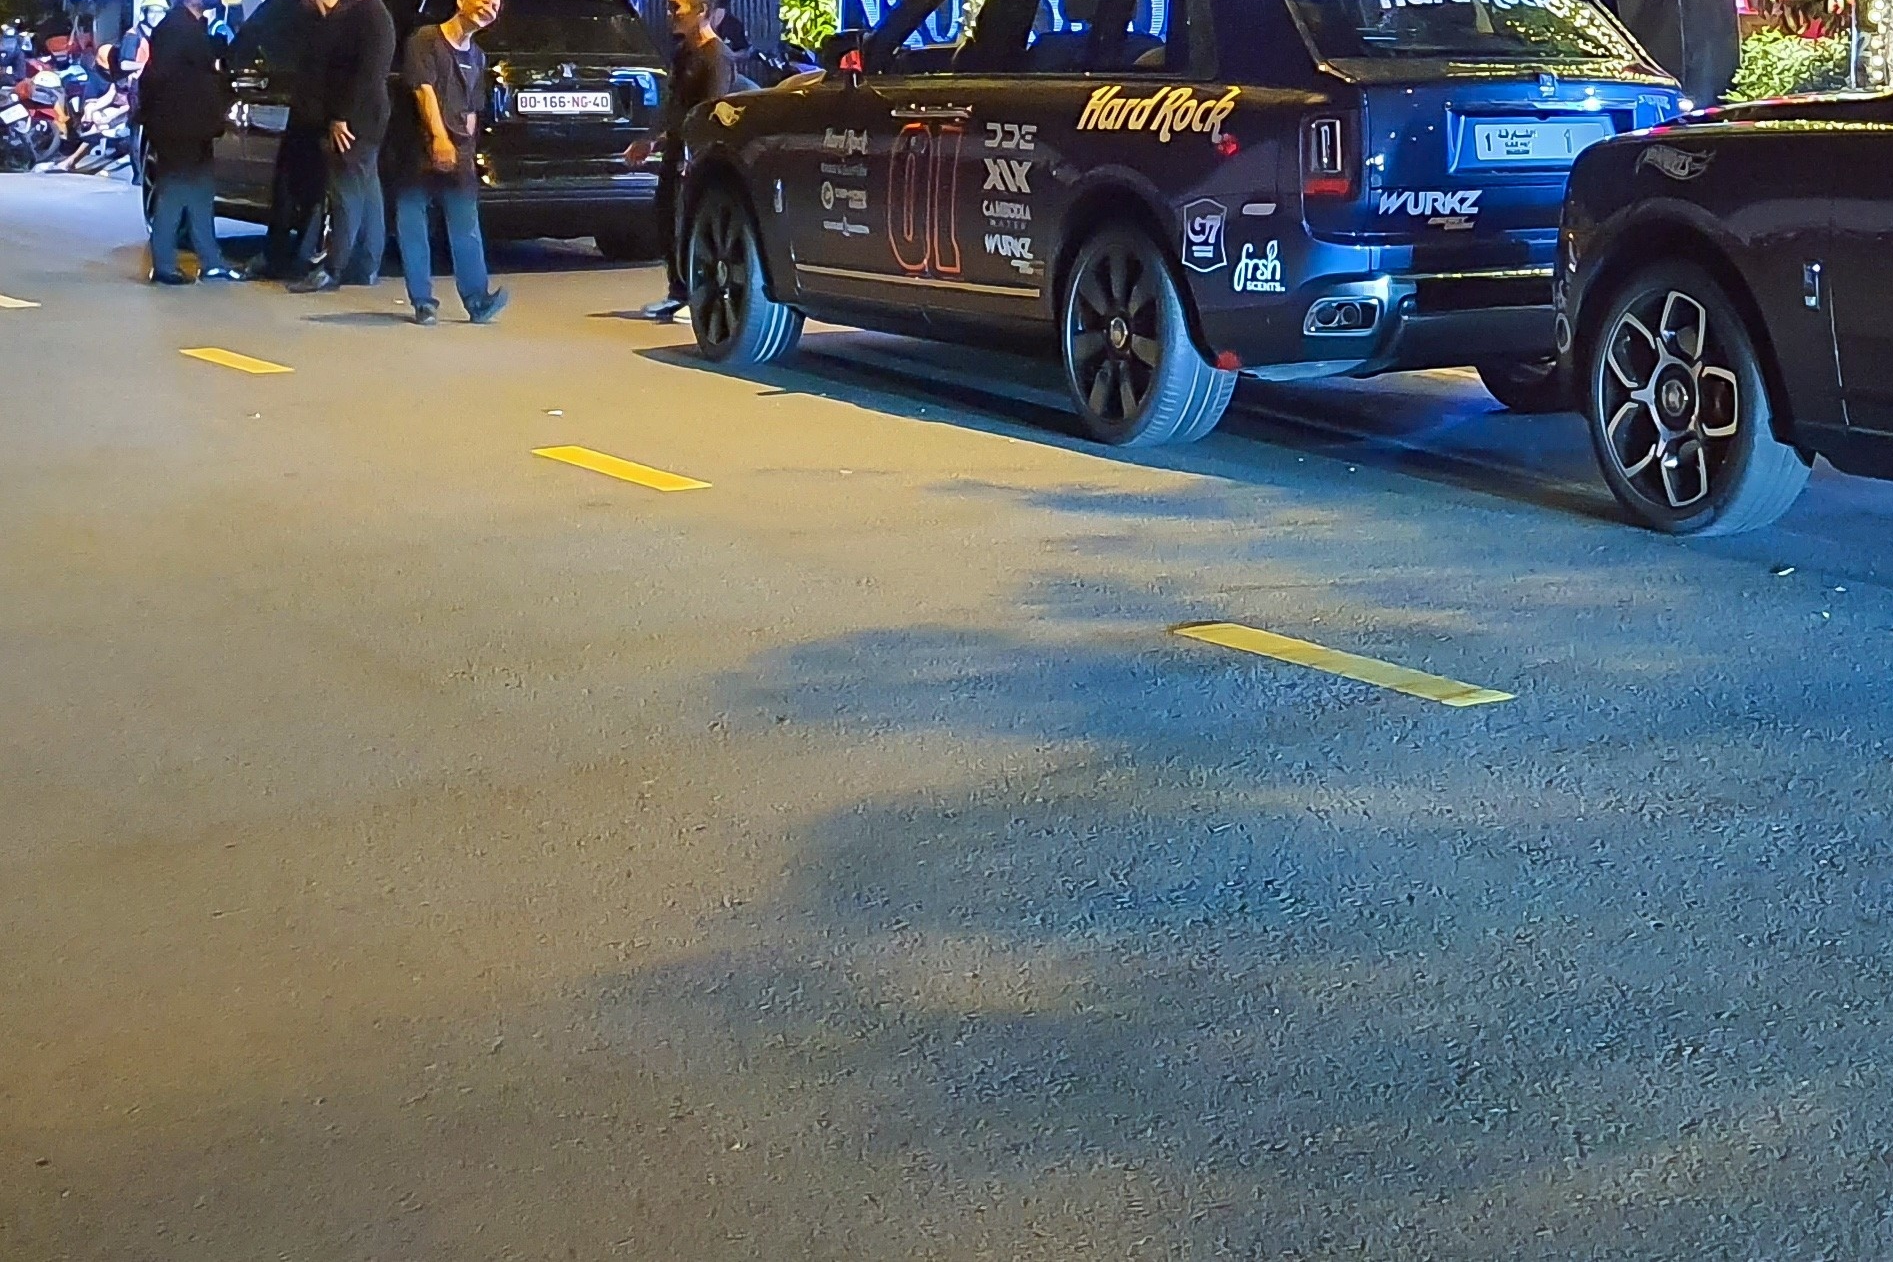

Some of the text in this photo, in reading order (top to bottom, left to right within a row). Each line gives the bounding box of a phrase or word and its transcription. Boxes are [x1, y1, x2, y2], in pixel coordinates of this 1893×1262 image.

[1076, 85, 1242, 143] Hard Rock
[1379, 189, 1483, 216] WURKZ
[1233, 239, 1281, 292] frsh
